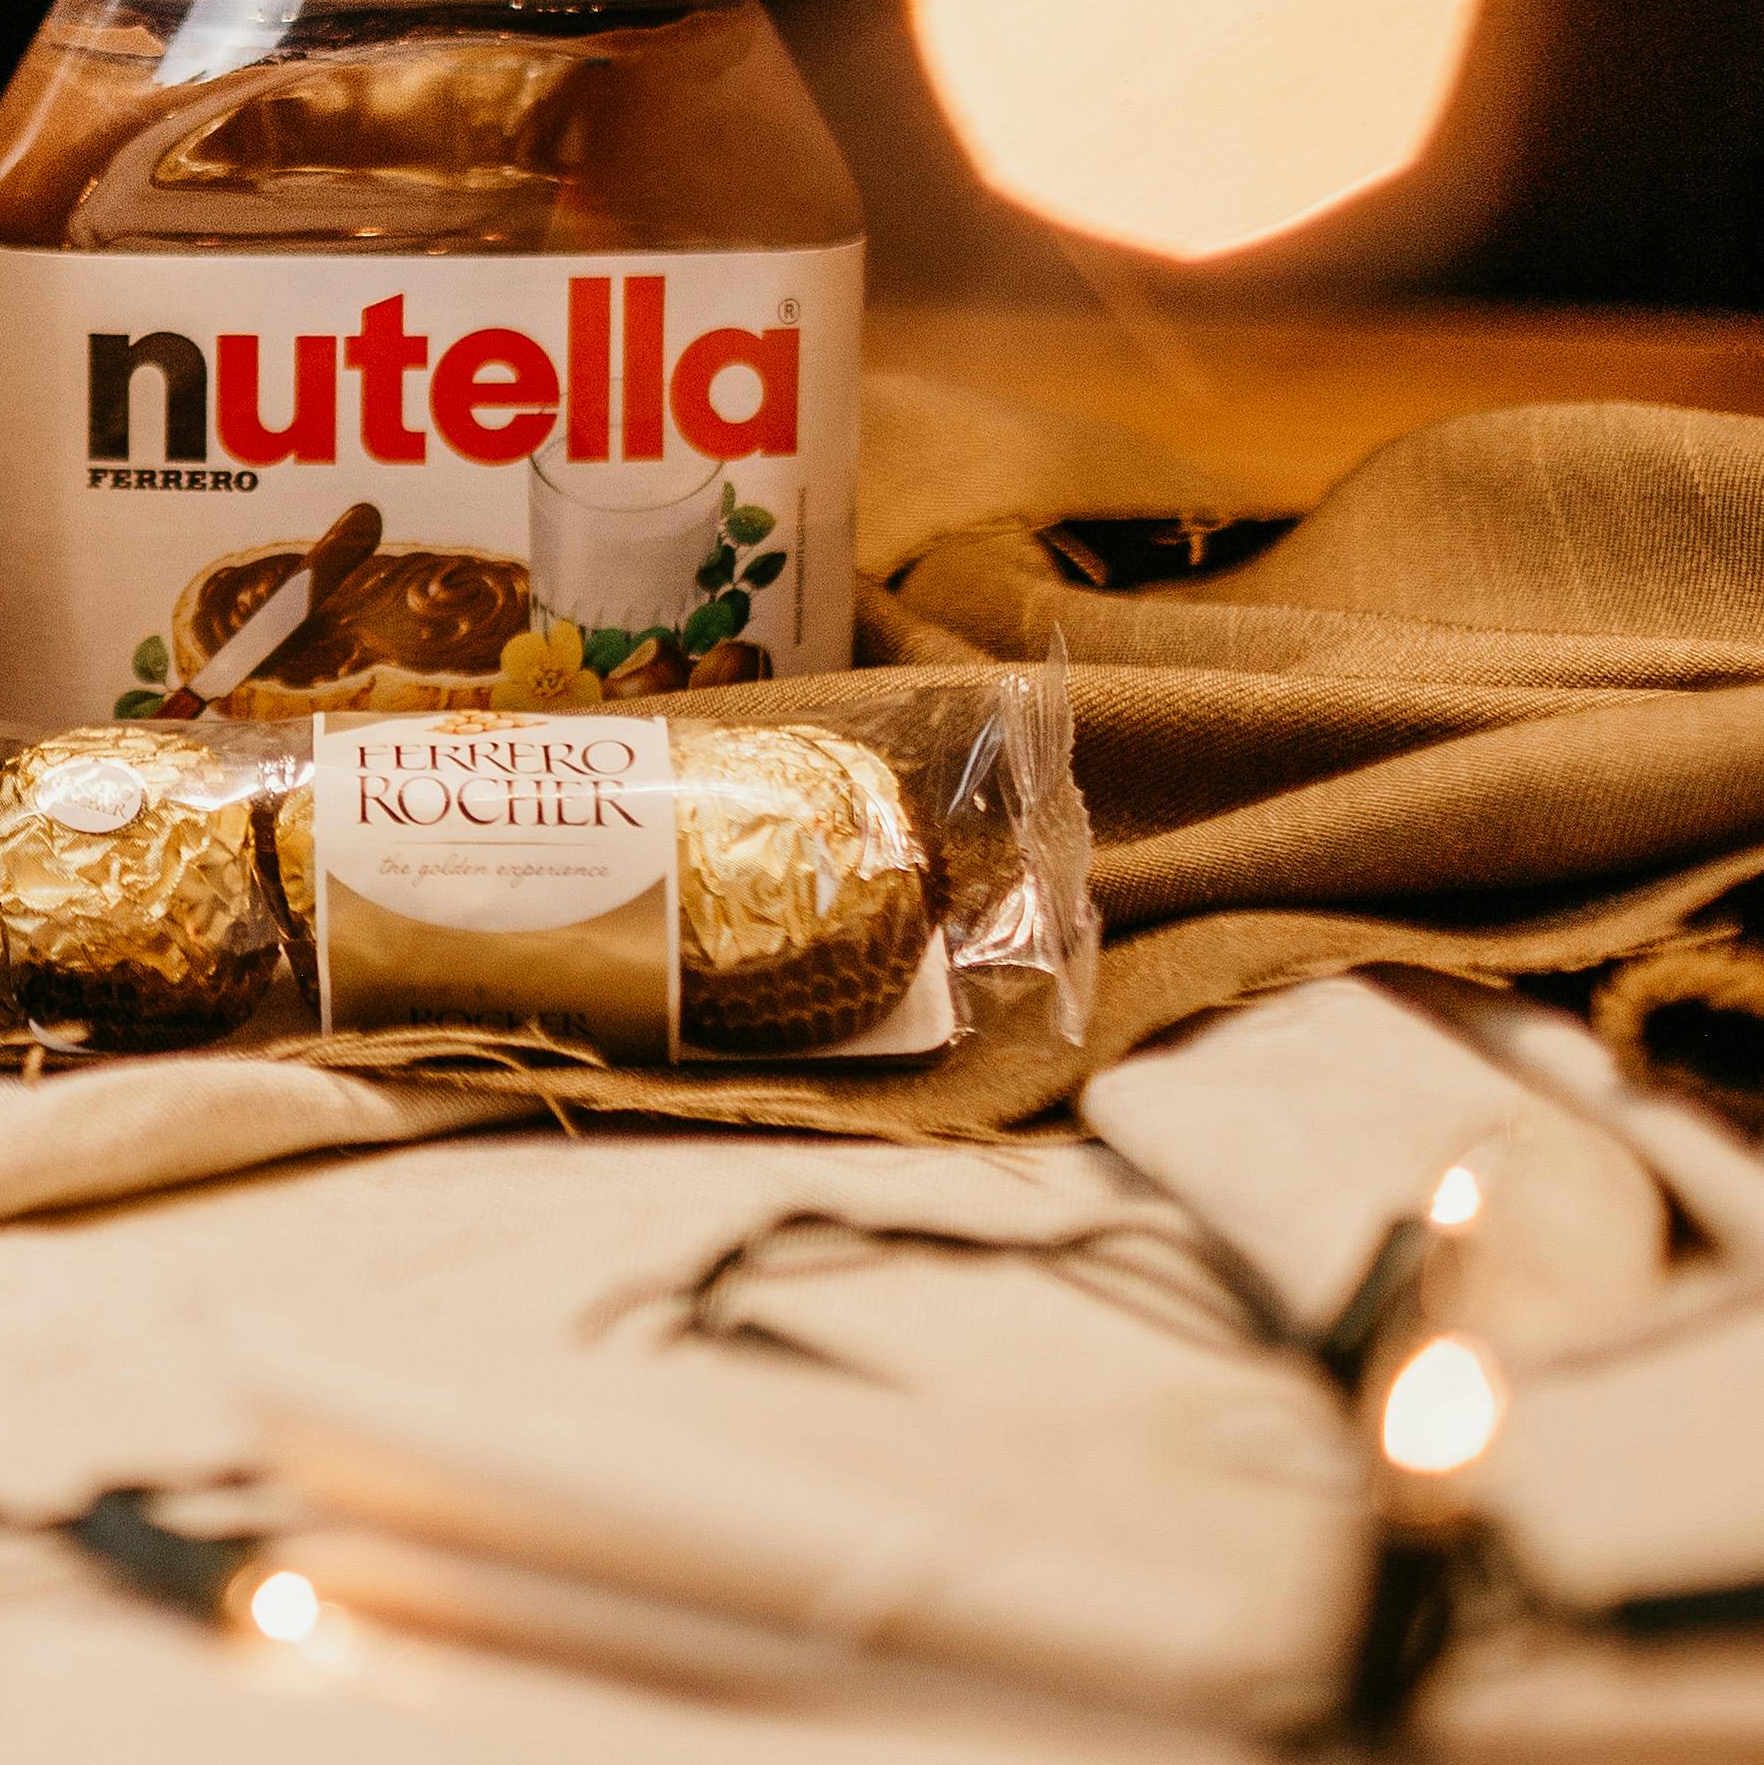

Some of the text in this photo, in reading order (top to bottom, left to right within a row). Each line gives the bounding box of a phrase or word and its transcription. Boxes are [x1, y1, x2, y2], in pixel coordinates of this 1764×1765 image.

[85, 274, 802, 467] nutella
[87, 467, 260, 493] FERRERO
[356, 739, 637, 776] FERRERO
[356, 774, 646, 829] ROCHER
[378, 852, 610, 889] the golden experience
